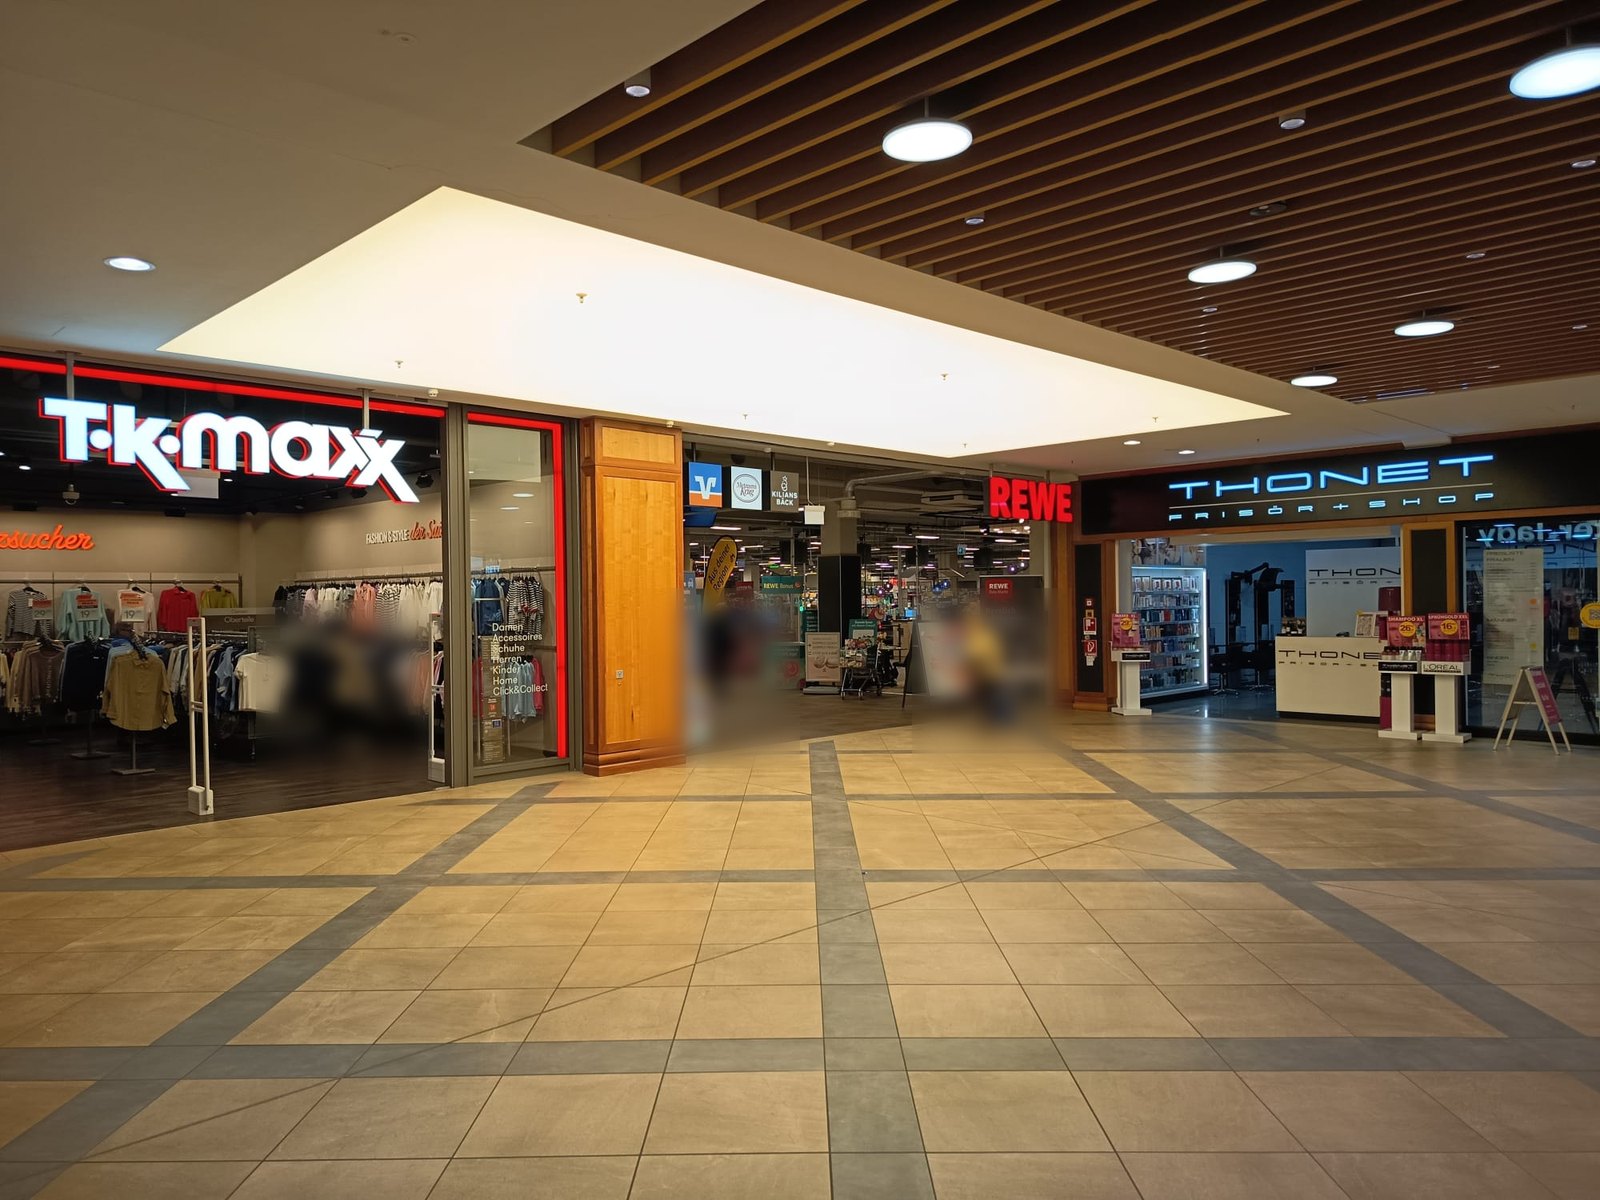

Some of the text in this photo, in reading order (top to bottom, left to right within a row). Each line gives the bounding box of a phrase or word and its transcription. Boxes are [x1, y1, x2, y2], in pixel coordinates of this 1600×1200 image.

[1168, 454, 1494, 500] THONET
[771, 491, 798, 499] KILIANS
[988, 475, 1073, 523] REWE
[492, 622, 524, 632] Damen
[492, 632, 543, 643] Accessoires
[493, 645, 525, 654] Schuhe
[493, 655, 522, 664] Herren
[493, 665, 521, 674] Kinder
[493, 676, 518, 685] Home
[493, 683, 548, 696] Click&Collect
